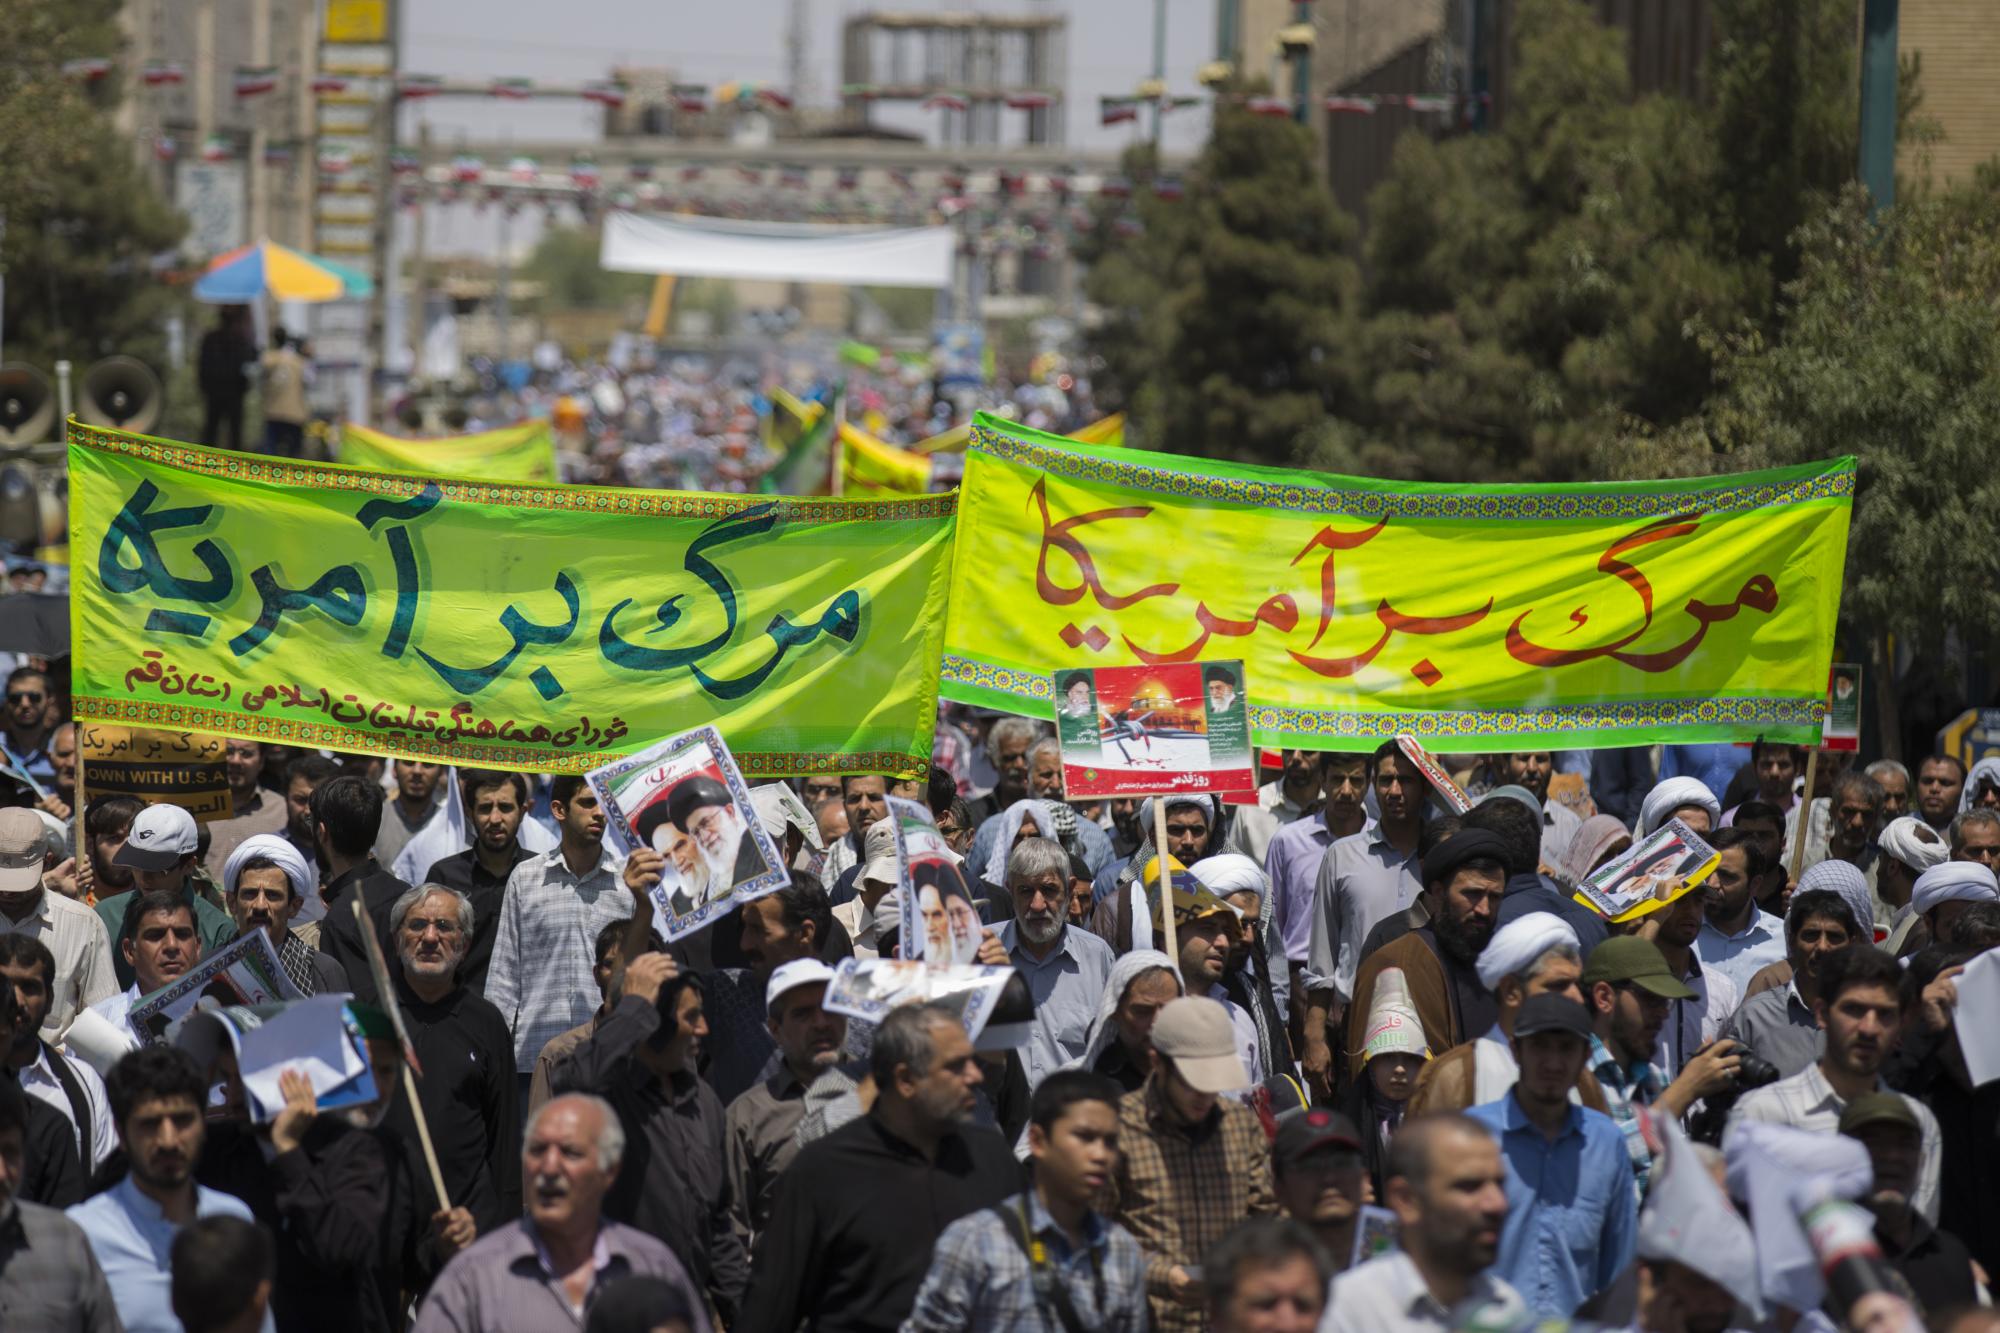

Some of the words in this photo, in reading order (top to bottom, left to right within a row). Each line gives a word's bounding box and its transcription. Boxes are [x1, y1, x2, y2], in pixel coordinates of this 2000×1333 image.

[98, 477, 444, 660] آمریکا
[1026, 473, 1391, 666] آمریکا
[599, 500, 862, 701] مرگ
[1504, 513, 1779, 674] مرگ
[416, 570, 581, 702] بر
[1285, 594, 1494, 687] بر
[125, 650, 163, 692] قم
[159, 665, 231, 701] استان
[242, 683, 330, 712] اسلامی
[330, 694, 440, 740] تبلیغات
[171, 731, 219, 759] مرگ
[434, 702, 551, 745] هماهنگی
[551, 716, 629, 748] شورای
[143, 739, 163, 759] بر
[84, 768, 126, 783] OWN
[130, 769, 174, 785] WITH
[178, 770, 226, 785] U.S.A
